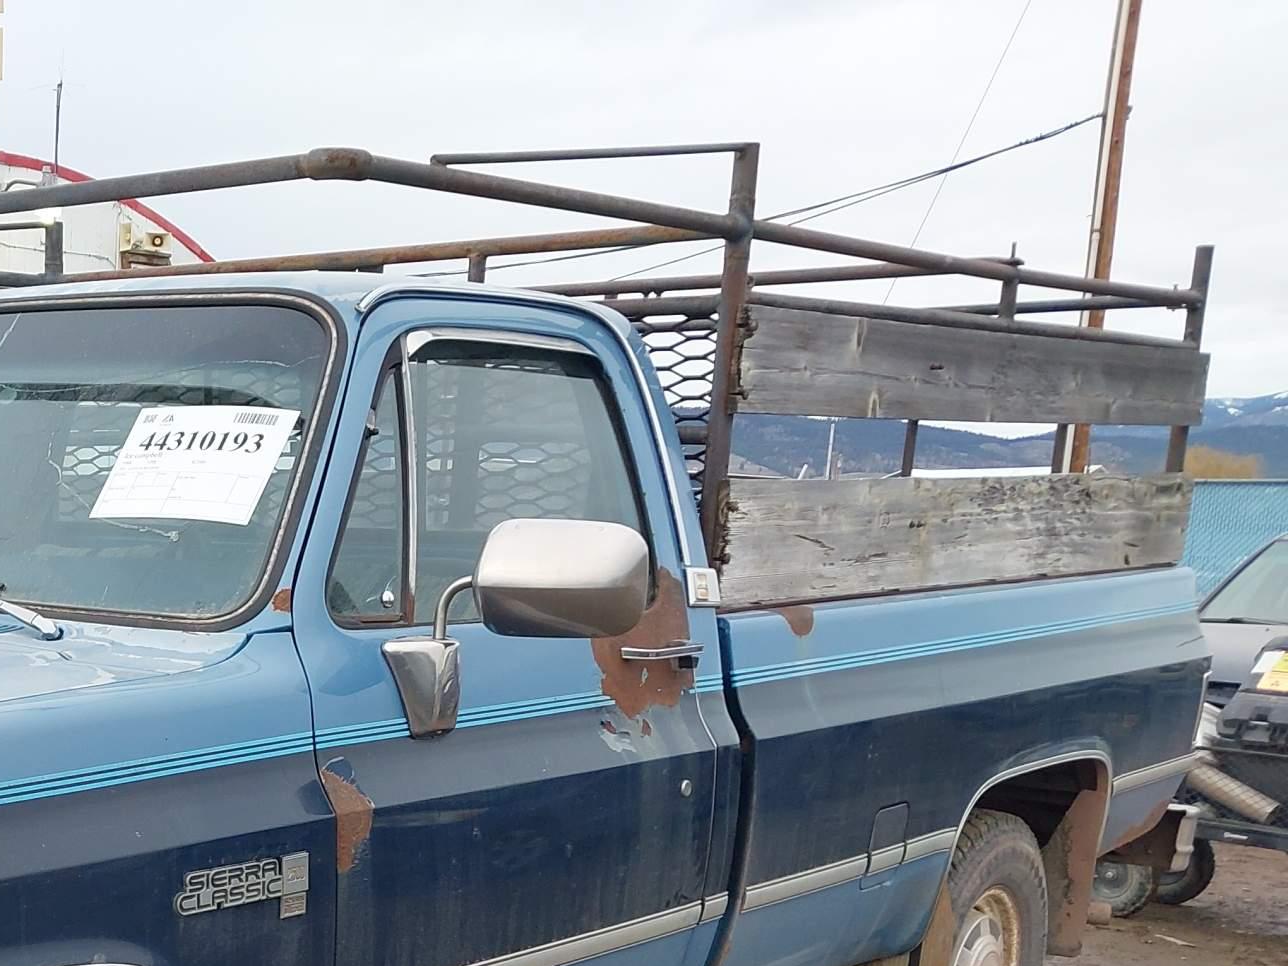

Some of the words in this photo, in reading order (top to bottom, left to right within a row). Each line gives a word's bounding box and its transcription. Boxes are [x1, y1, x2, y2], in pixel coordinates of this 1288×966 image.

[139, 431, 265, 454] 44310193
[186, 859, 279, 894] SIERRA
[176, 877, 282, 913] CLASSIC
